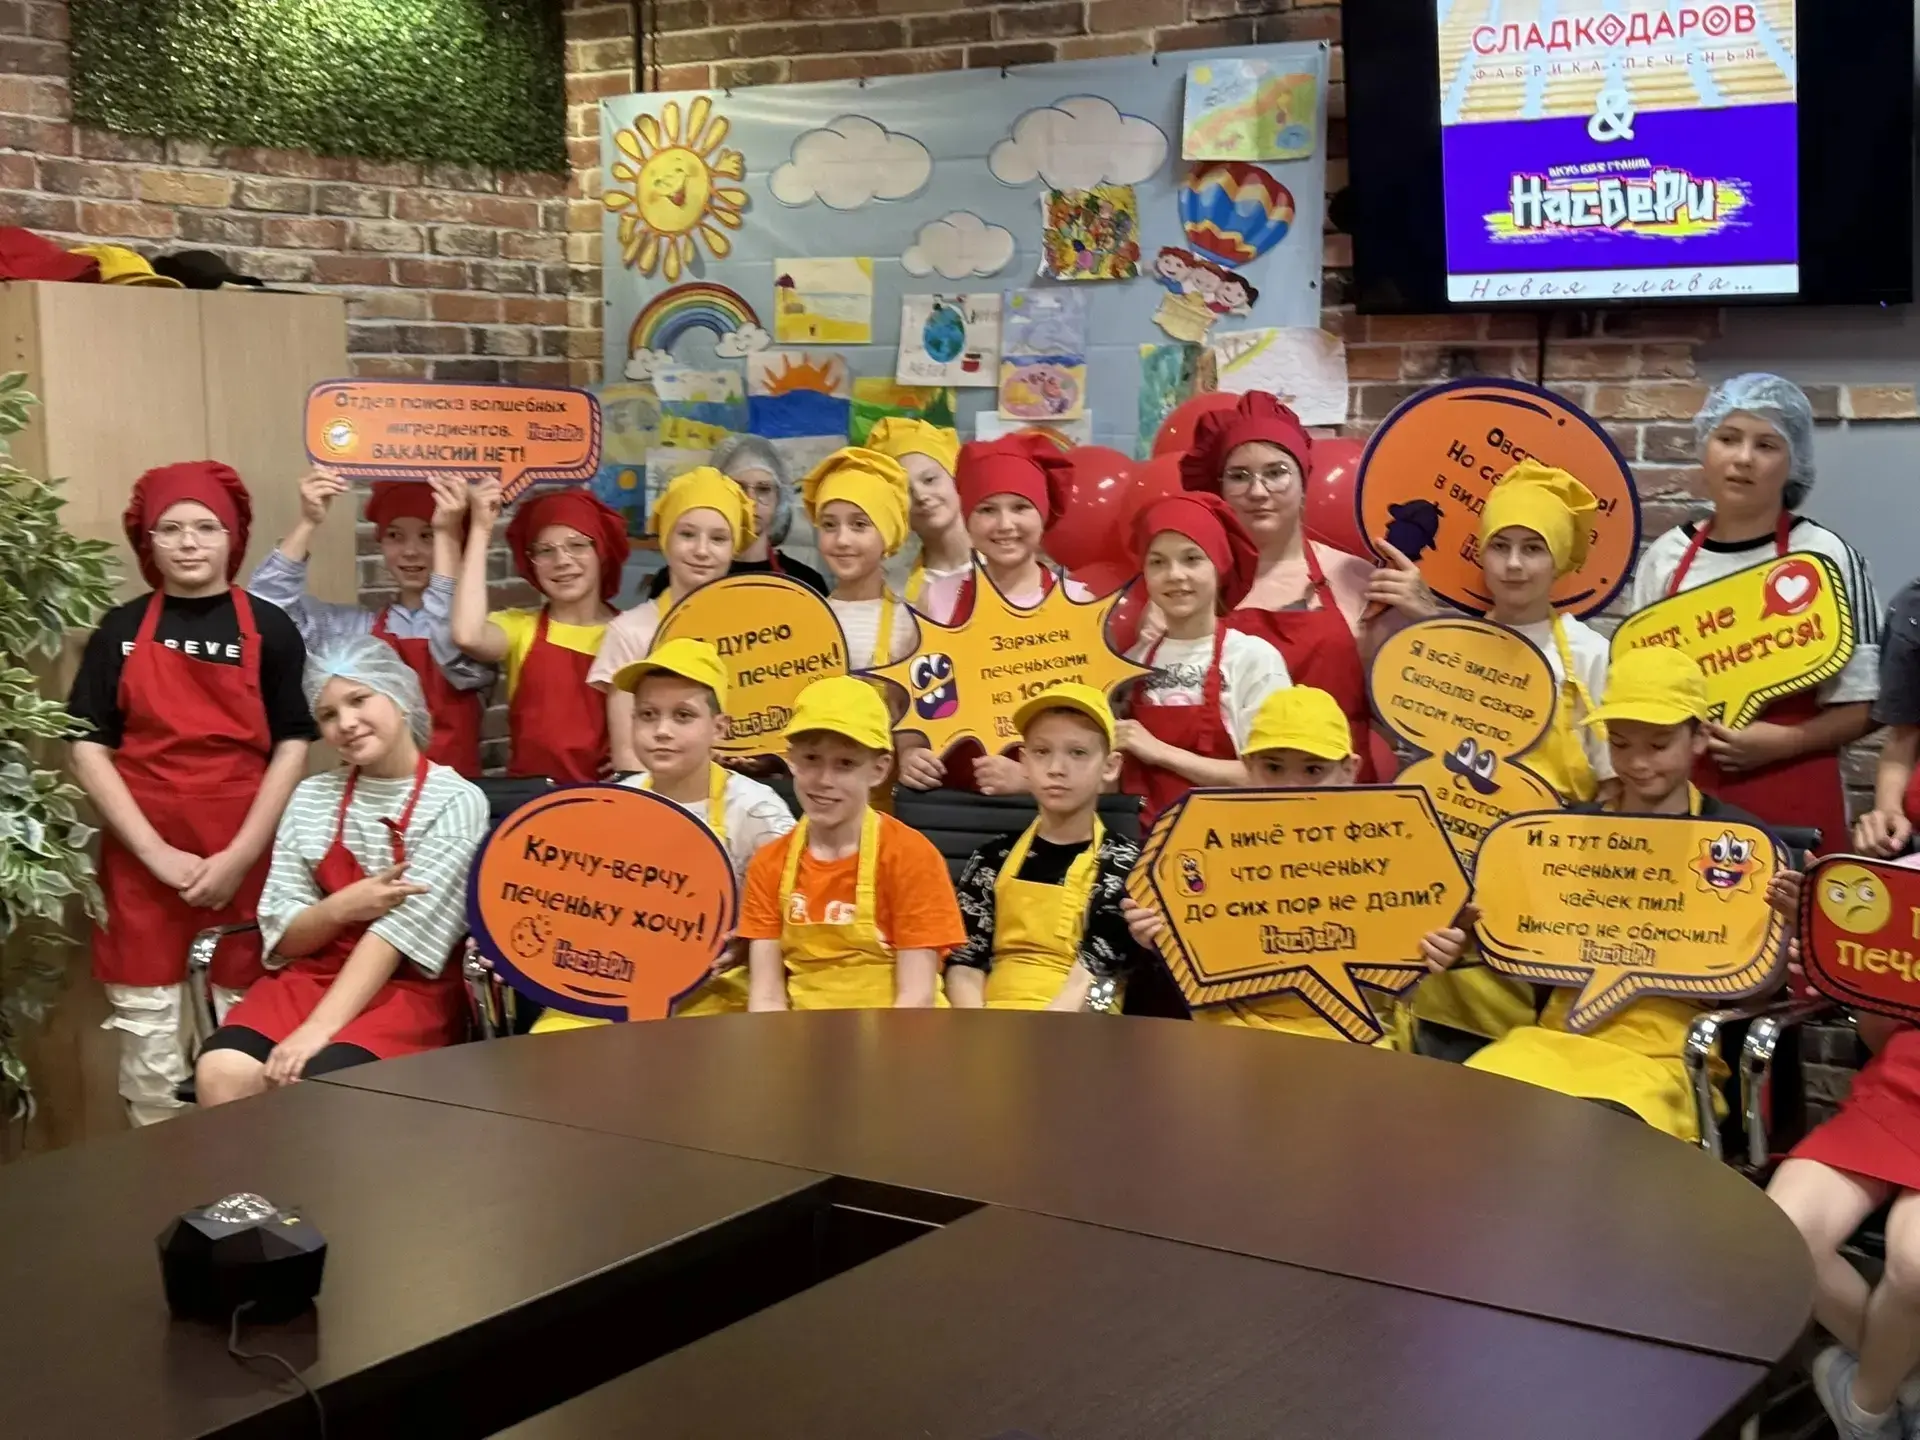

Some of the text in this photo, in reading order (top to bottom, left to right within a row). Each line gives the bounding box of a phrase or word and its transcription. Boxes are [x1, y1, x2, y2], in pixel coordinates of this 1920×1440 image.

[1472, 5, 1757, 54] СЛАДКОДАРОВ
[1475, 49, 1757, 80] ФАБРИКА ПЕЧЕНЬЯ
[1587, 90, 1636, 142] &
[1470, 277, 1586, 299] Новая
[335, 392, 567, 412] Отдел поиска волшебных
[371, 442, 526, 463] ВАКАНСИЙ НЕТ!
[1447, 439, 1475, 468] Но
[1449, 482, 1486, 517] вид
[988, 628, 1072, 651] Заряжен
[737, 642, 842, 689] печенек!
[979, 653, 1090, 680] печеньками
[1409, 638, 1532, 692] Я всё видел!
[991, 691, 1013, 704] на
[1401, 666, 1476, 702] Сначала
[1390, 693, 1448, 723] потом
[1436, 787, 1448, 800] а
[1204, 827, 1225, 850] А
[1231, 823, 1284, 848] ничё
[1293, 825, 1337, 844] тот
[1526, 829, 1543, 847] И
[1548, 833, 1560, 848] я
[1567, 835, 1602, 851] тут
[523, 835, 697, 898] Кручу-верчу,
[1231, 855, 1390, 883] что печеньку
[1541, 861, 1637, 881] печеньки
[500, 881, 707, 942] печеньку хочу!
[1184, 881, 1448, 925] до сих пор не дали?
[1558, 889, 1686, 913] чаёчек пил!
[1516, 914, 1728, 946] Ничего не обмочил!
